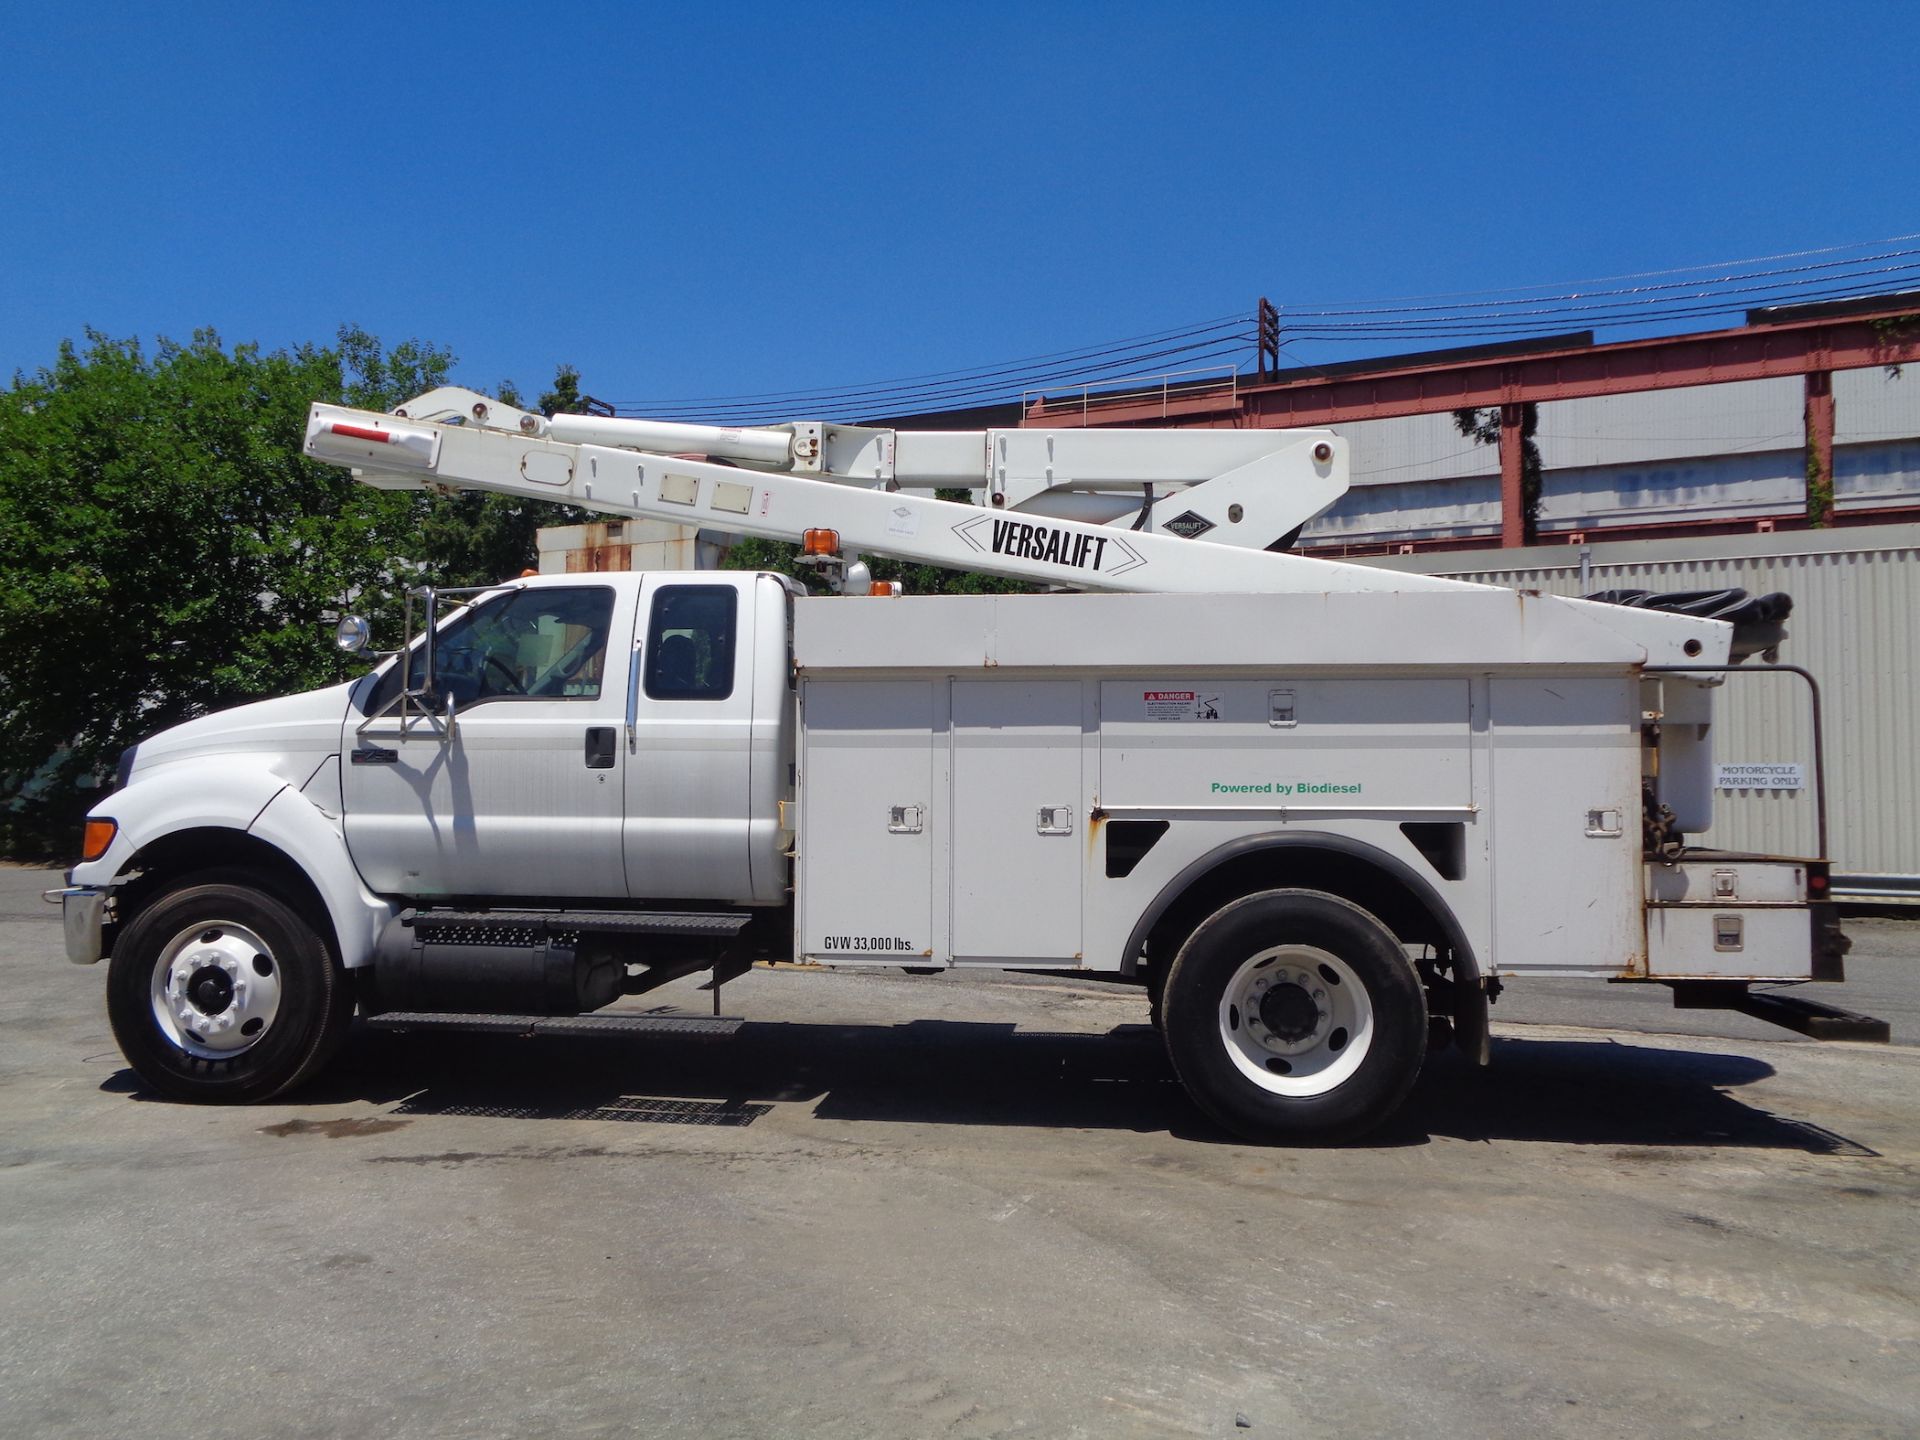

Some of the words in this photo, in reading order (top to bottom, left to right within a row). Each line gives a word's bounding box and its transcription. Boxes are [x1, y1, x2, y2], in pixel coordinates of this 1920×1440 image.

[1170, 521, 1202, 530] VERSALIFT
[991, 519, 1108, 571] VERSALIFT
[1158, 692, 1191, 700] DANGER
[1722, 766, 1796, 775] MOTORCYCLE
[1719, 776, 1768, 785] PARKING
[1772, 776, 1801, 785] ONLY
[1211, 783, 1272, 793] Powered
[1276, 783, 1293, 796] by
[1297, 783, 1362, 794] Biodiesel
[824, 936, 851, 950] GVW
[854, 937, 892, 952] 33,000
[894, 937, 914, 951] lbs.
